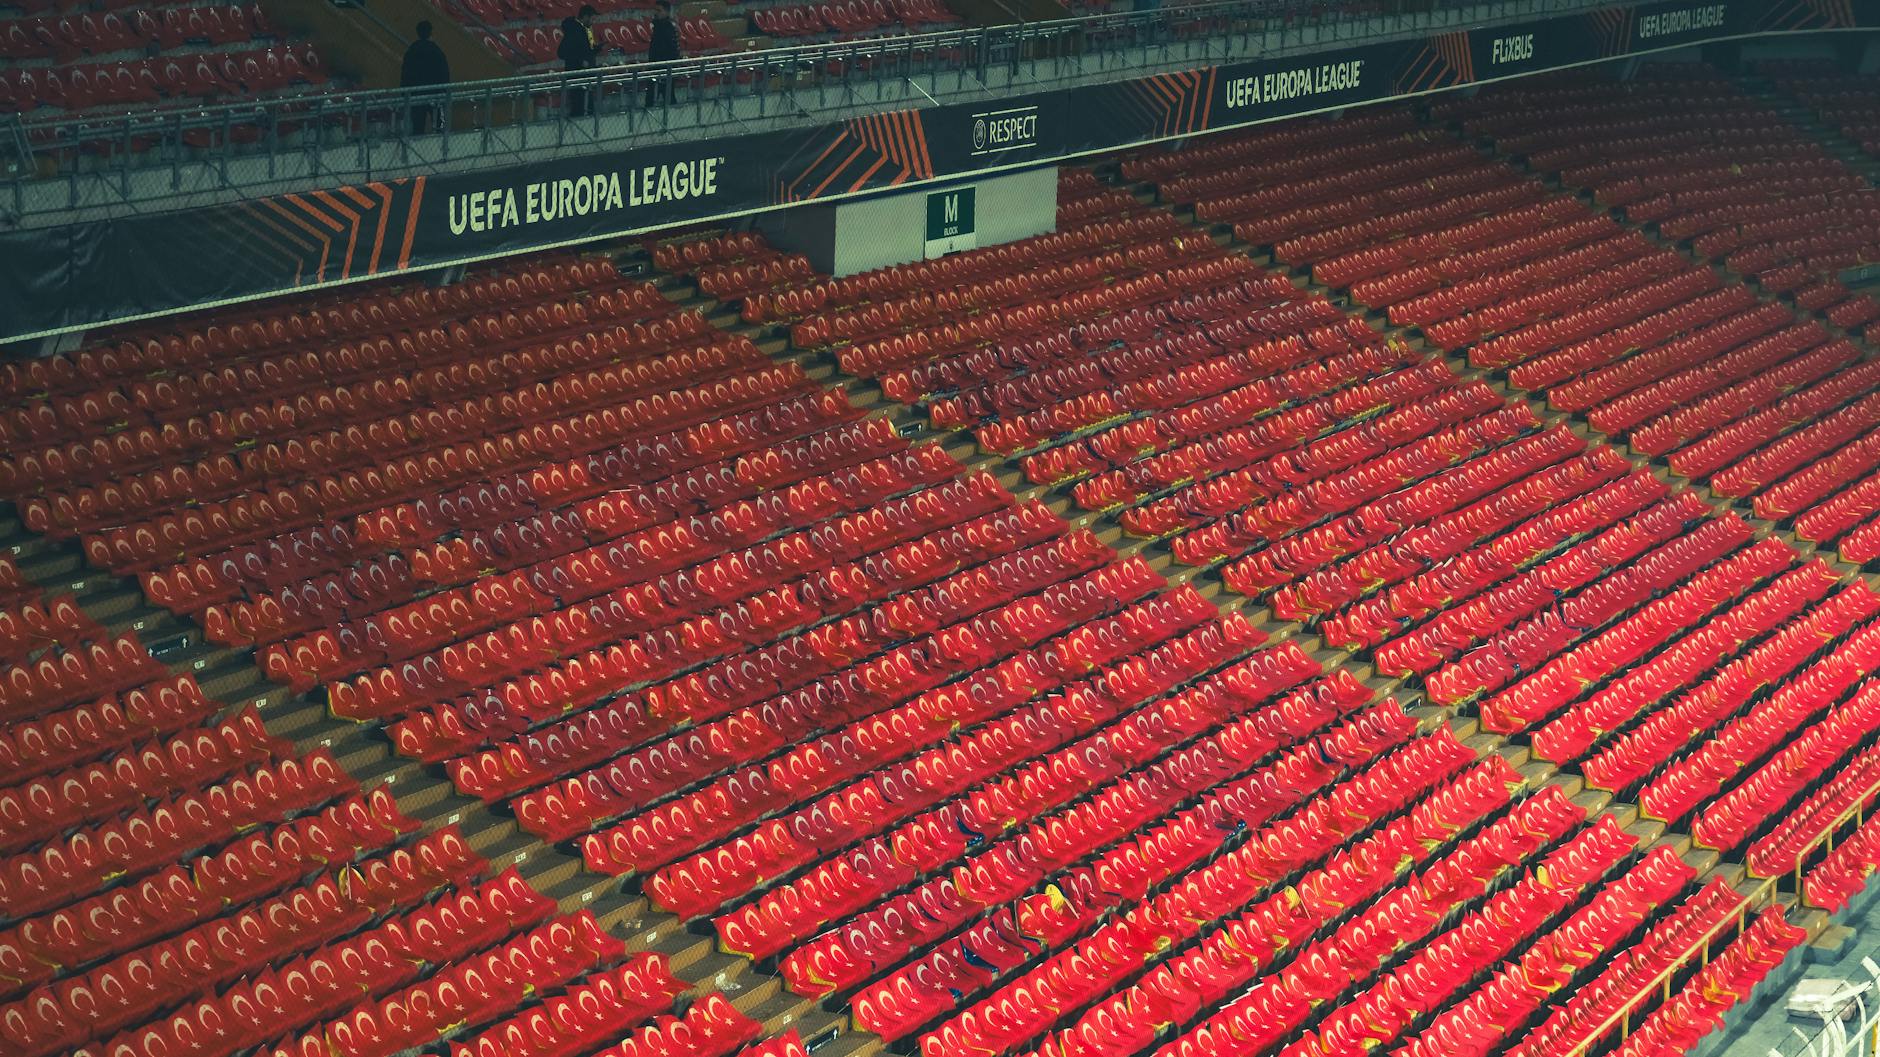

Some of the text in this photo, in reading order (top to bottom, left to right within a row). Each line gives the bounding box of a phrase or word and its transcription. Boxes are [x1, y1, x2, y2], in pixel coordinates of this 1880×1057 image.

[1639, 4, 1725, 39] UEFA EUROPA LEAGUE
[1226, 60, 1361, 109] UEFA EUROPA LEAGUE
[989, 114, 1038, 144] RESPECT
[449, 187, 520, 236] UEFA
[526, 172, 624, 224] EUROPA
[944, 193, 959, 224] M
[943, 226, 959, 237] BLOCK
